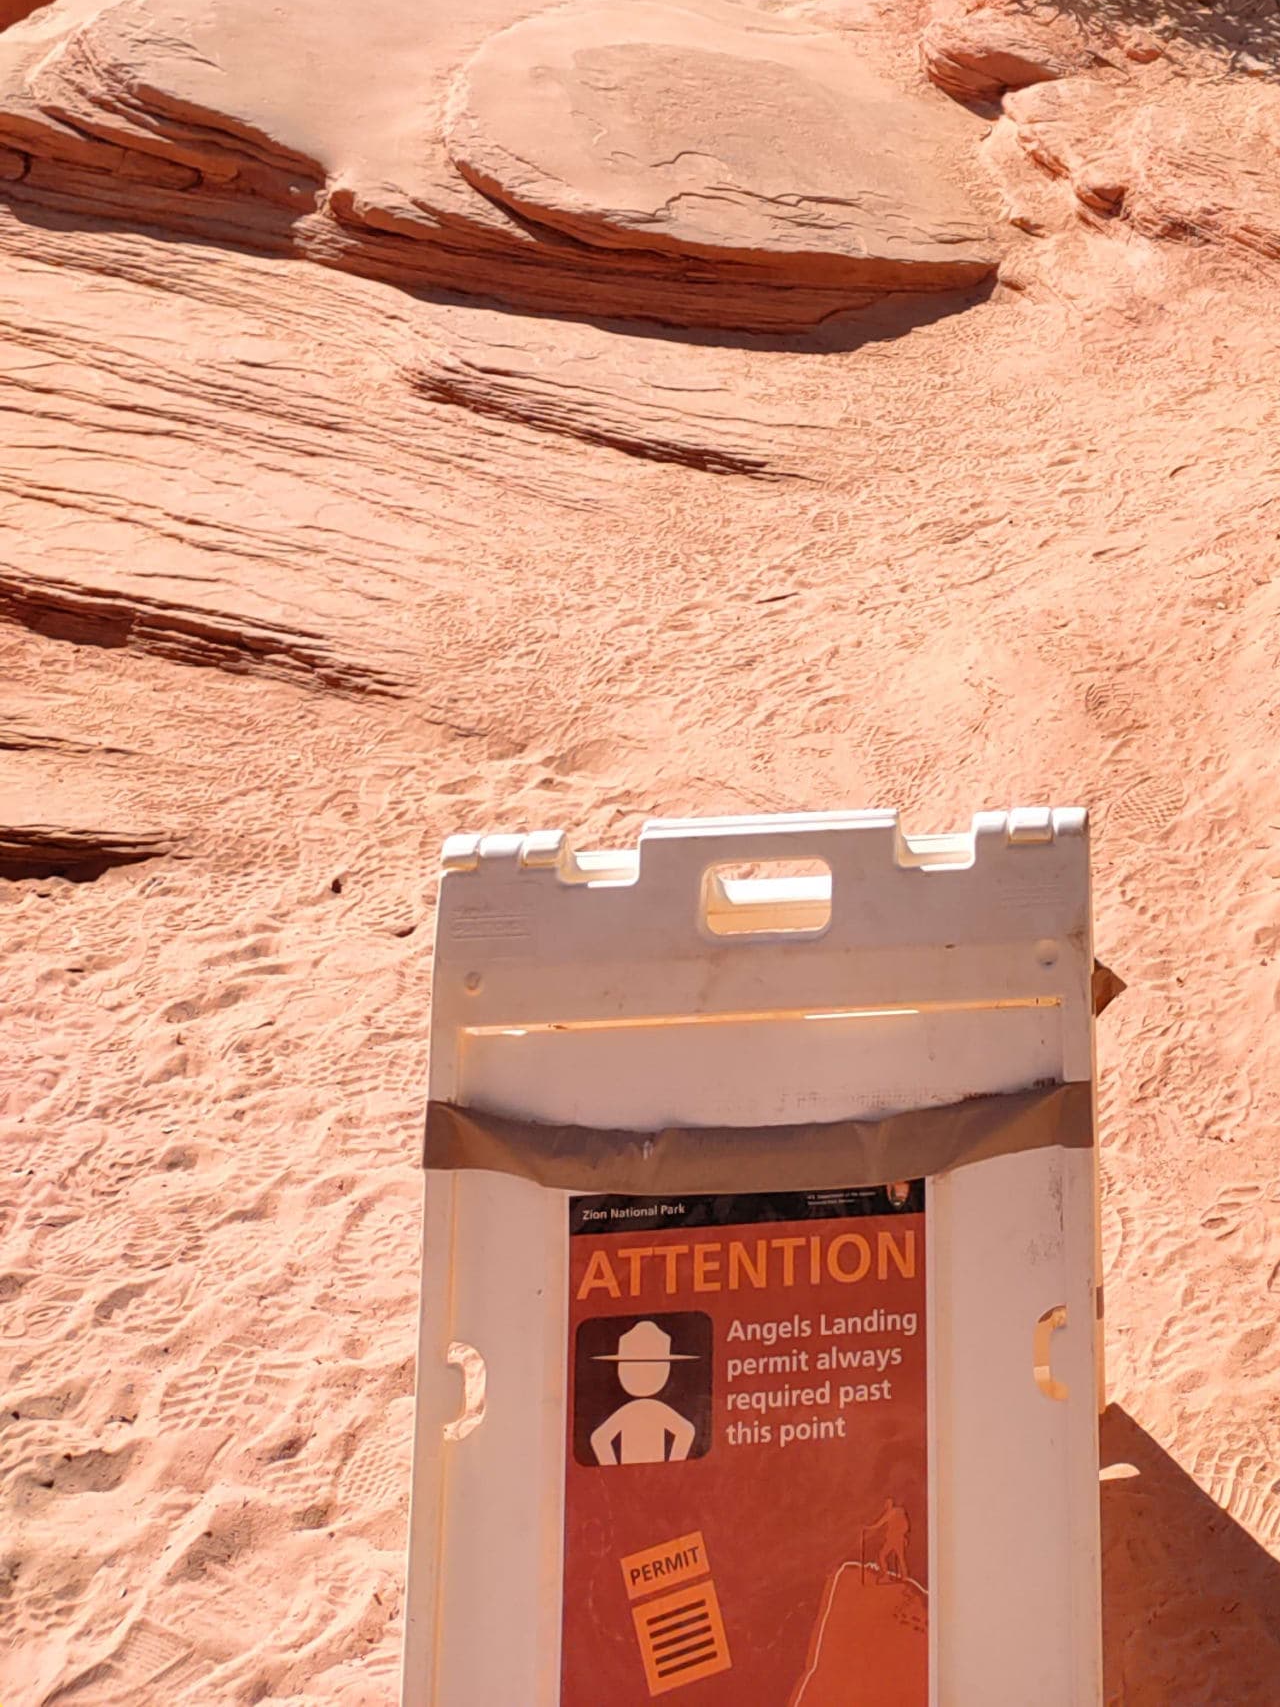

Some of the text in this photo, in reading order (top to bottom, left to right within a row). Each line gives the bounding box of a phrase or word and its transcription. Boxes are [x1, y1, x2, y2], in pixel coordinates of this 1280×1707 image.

[582, 1203, 685, 1220] Zion National Park
[576, 1230, 917, 1300] ATTENTION
[727, 1309, 917, 1345] Angels Landing
[727, 1347, 902, 1382] permit always
[727, 1379, 891, 1414] required past
[726, 1416, 846, 1447] this point
[630, 1546, 699, 1586] PERMIT
